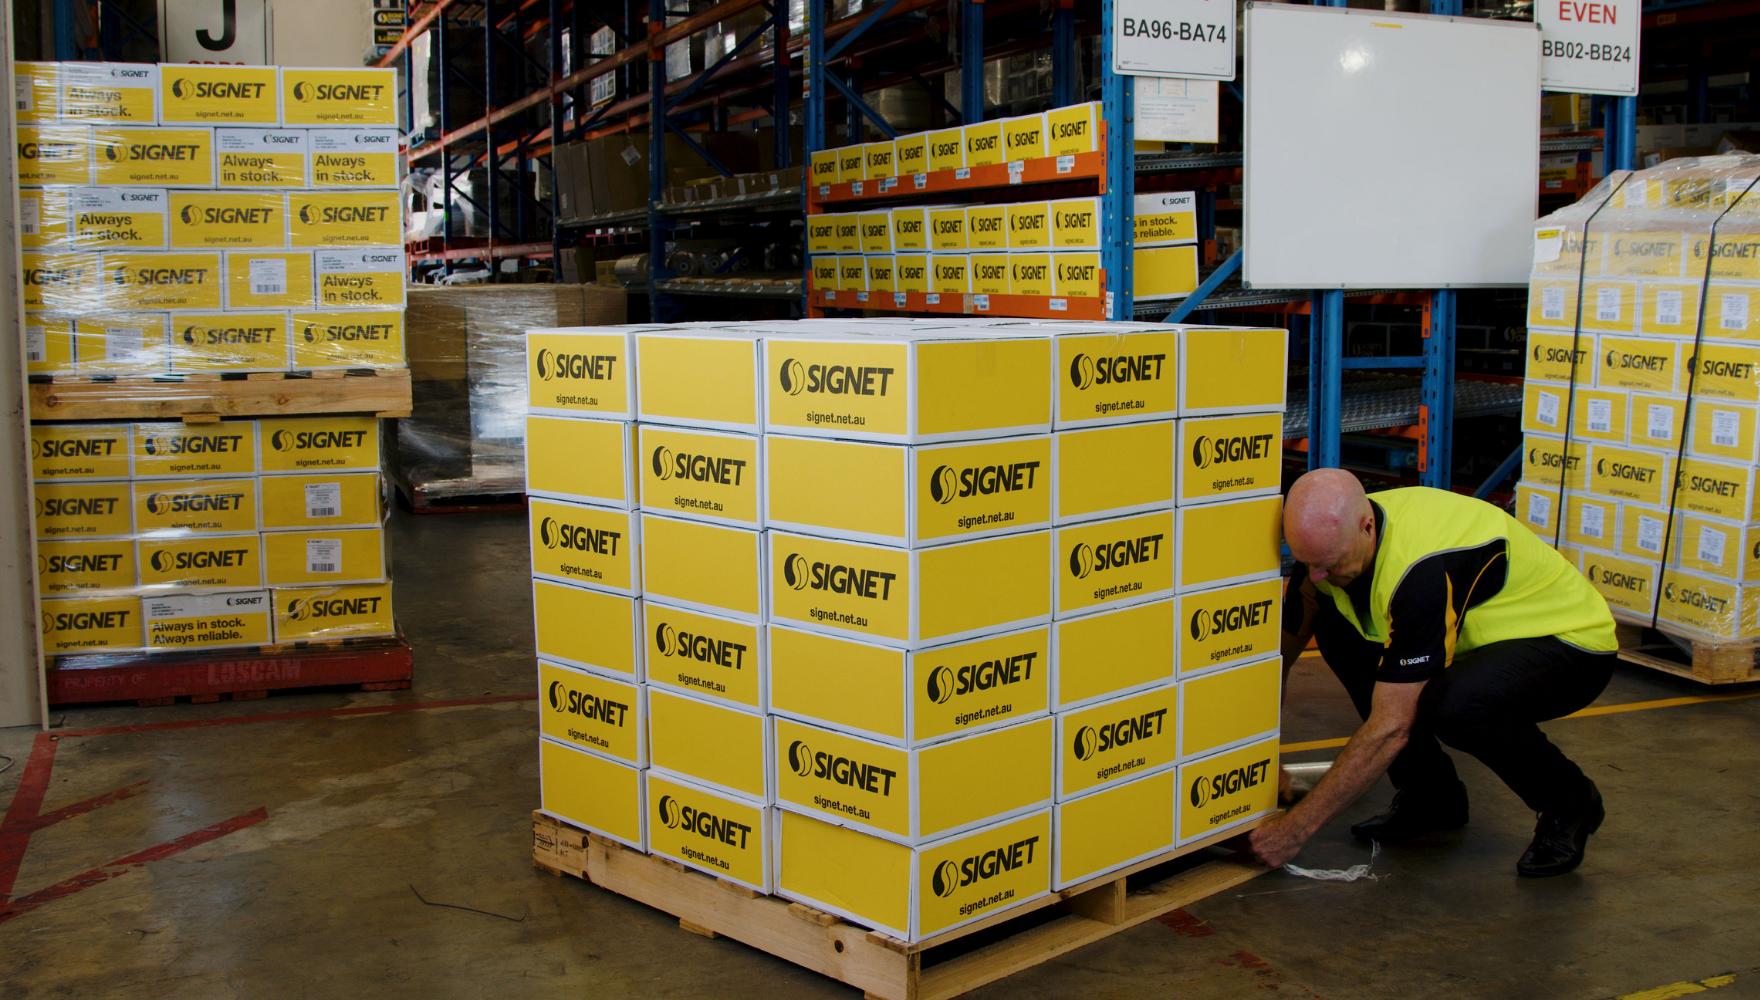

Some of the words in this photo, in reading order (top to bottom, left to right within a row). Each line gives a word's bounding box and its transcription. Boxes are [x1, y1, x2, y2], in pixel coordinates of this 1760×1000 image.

[1559, 1, 1617, 25] EVEN
[196, 0, 237, 51] J
[1123, 18, 1226, 43] BA96-BA74
[1542, 40, 1631, 63] BB02-BB24
[121, 70, 149, 78] SIGNET
[69, 88, 122, 103] Always
[196, 82, 265, 99] SIGNET
[316, 84, 384, 101] SIGNET
[86, 105, 131, 117] stock.
[196, 111, 244, 119] signet.net.au
[1060, 120, 1087, 138] SIGNET
[272, 136, 300, 144] SIGNET
[975, 136, 998, 151] SIGNET
[1015, 131, 1040, 146] SIGNET
[18, 143, 77, 160] IGNET
[130, 144, 200, 161] SIGNET
[904, 146, 924, 160] SIGNET
[938, 142, 959, 156] SIGNET
[223, 155, 274, 169] Always
[315, 155, 366, 169] Always
[845, 157, 861, 170] SIGNET
[873, 152, 892, 166] SIGNET
[129, 172, 179, 181] signet.net.au
[223, 170, 236, 181] in
[240, 170, 283, 182] stock.
[316, 170, 329, 181] in
[333, 170, 375, 181] stock.
[819, 162, 835, 174] SIGNET
[1169, 197, 1191, 205] SIGNET
[80, 213, 132, 227] Always
[204, 207, 273, 225] SIGNET
[322, 206, 389, 223] SIGNET
[1019, 214, 1045, 230] SIGNET
[1065, 212, 1092, 229] SIGNET
[1139, 218, 1148, 227] in
[1150, 216, 1178, 226] stock.
[816, 225, 833, 237] SIGNET
[841, 225, 856, 237] SIGNET
[869, 225, 886, 237] SIGNET
[903, 221, 922, 233] SIGNET
[940, 220, 963, 234] SIGNET
[979, 217, 1002, 232] SIGNET
[1140, 227, 1175, 238] reliable.
[97, 229, 142, 240] stock.
[204, 236, 252, 244] signet.net.au
[322, 234, 369, 242] signet.net.au
[1629, 241, 1676, 257] SIGNET
[371, 255, 398, 263] SIGNET
[23, 269, 86, 286] IGNET
[139, 268, 208, 285] SIGNET
[323, 275, 373, 288] Always
[819, 268, 836, 279] SIGNET
[846, 267, 862, 279] SIGNET
[875, 269, 891, 280] SIGNET
[905, 267, 924, 279] SIGNET
[942, 266, 965, 280] SIGNET
[982, 266, 1006, 280] SIGNET
[1021, 266, 1047, 280] SIGNET
[1067, 266, 1095, 281] SIGNET
[324, 290, 336, 301] in
[341, 289, 382, 301] stock.
[207, 327, 275, 345] SIGNET
[327, 325, 393, 341] SIGNET
[556, 353, 617, 381] SIGNET
[1095, 353, 1166, 385] SIGNET
[1621, 353, 1668, 372] SIGNET
[1702, 360, 1754, 380] SIGNET
[807, 364, 894, 397] SIGNET
[556, 394, 598, 407] signet.net.au
[1095, 398, 1145, 413] signet.net.au
[806, 411, 866, 426] signet.net.au
[42, 439, 117, 457] SIGNET
[169, 435, 242, 454] SIGNET
[296, 430, 367, 450] SIGNET
[1213, 434, 1274, 464] SIGNET
[169, 463, 221, 472] signet.net.au
[295, 458, 346, 468] signet.net.au
[675, 452, 746, 487] SIGNET
[1541, 452, 1581, 471] SIGNET
[42, 467, 94, 476] signet.net.au
[959, 461, 1040, 498] SIGNET
[1611, 463, 1656, 483] SIGNET
[1212, 475, 1254, 490] signet.net.au
[1689, 476, 1740, 498] SIGNET
[45, 498, 119, 516] SIGNET
[171, 493, 244, 512] SIGNET
[674, 495, 723, 512] signet.net.au
[171, 521, 222, 530] signet.net.au
[958, 510, 1015, 529] signet.net.au
[45, 526, 96, 535] signet.net.au
[560, 523, 621, 557] SIGNET
[177, 549, 248, 570] SIGNET
[1094, 533, 1164, 573] SIGNET
[49, 554, 123, 573] SIGNET
[560, 563, 603, 580] signet.net.au
[810, 561, 897, 601] SIGNET
[1602, 570, 1646, 592] SIGNET
[1093, 580, 1143, 600] signet.net.au
[236, 597, 262, 606] SIGNET
[312, 596, 382, 618] SIGNET
[1680, 588, 1729, 614] SIGNET
[56, 611, 130, 631] SIGNET
[153, 622, 194, 633] Always
[197, 621, 207, 630] in
[210, 618, 246, 629] stock.
[810, 607, 868, 627] signet.net.au
[1211, 600, 1273, 635] SIGNET
[56, 639, 108, 649] signet.net.au
[153, 634, 194, 645] Always
[197, 630, 243, 642] reliable.
[677, 631, 747, 671] SIGNET
[1210, 642, 1253, 661] signet.net.au
[1406, 655, 1430, 666] SIGNET
[207, 658, 301, 686] LOSCAM
[956, 651, 1037, 696] SIGNET
[678, 672, 726, 694] signet.net.au
[568, 689, 629, 728] SIGNET
[955, 702, 1012, 726] signet.net.au
[567, 727, 609, 749] signet.net.au
[1098, 708, 1168, 752] SIGNET
[814, 751, 897, 797] SIGNET
[1097, 756, 1146, 780] signet.net.au
[1211, 758, 1271, 800] SIGNET
[813, 795, 870, 820] signet.net.au
[1209, 803, 1251, 826] signet.net.au
[681, 808, 752, 850] SIGNET
[681, 844, 730, 871] signet.net.au
[960, 836, 1039, 888] SIGNET
[959, 887, 1015, 916] signet.net.au
